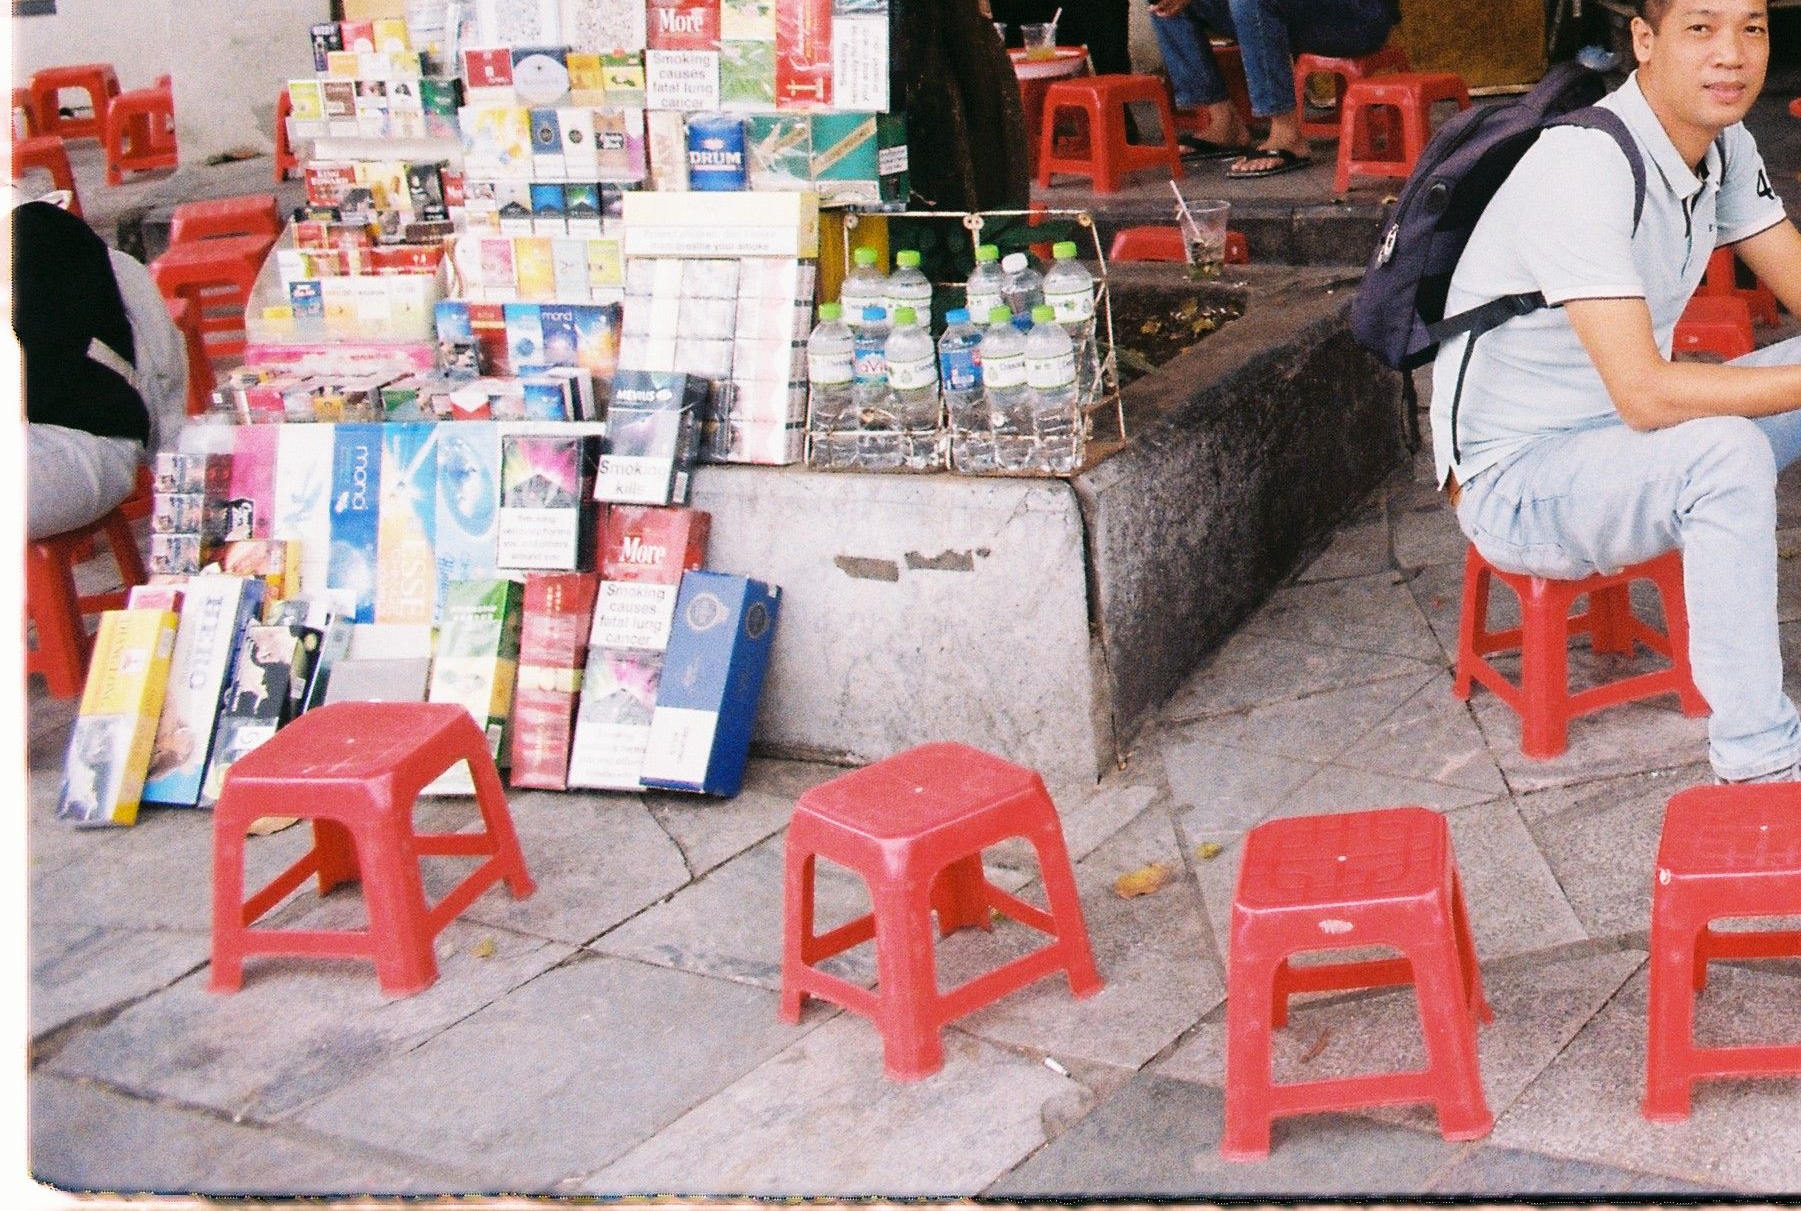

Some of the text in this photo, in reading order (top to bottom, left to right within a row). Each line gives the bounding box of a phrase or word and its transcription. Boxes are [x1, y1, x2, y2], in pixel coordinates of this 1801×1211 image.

[658, 8, 707, 33] More
[653, 52, 711, 68] Smoking
[658, 69, 706, 80] causes
[653, 81, 713, 95] fatal lung
[660, 97, 705, 109] cancer
[689, 150, 742, 166] DRUM
[1757, 169, 1775, 200] 4
[542, 310, 573, 321] mond
[600, 459, 666, 478] Smoking
[353, 445, 369, 511] mond
[620, 535, 667, 564] More
[606, 584, 666, 602] Smoking
[609, 602, 656, 614] causes
[599, 614, 662, 632] fatal lung
[605, 633, 652, 646] cancer
